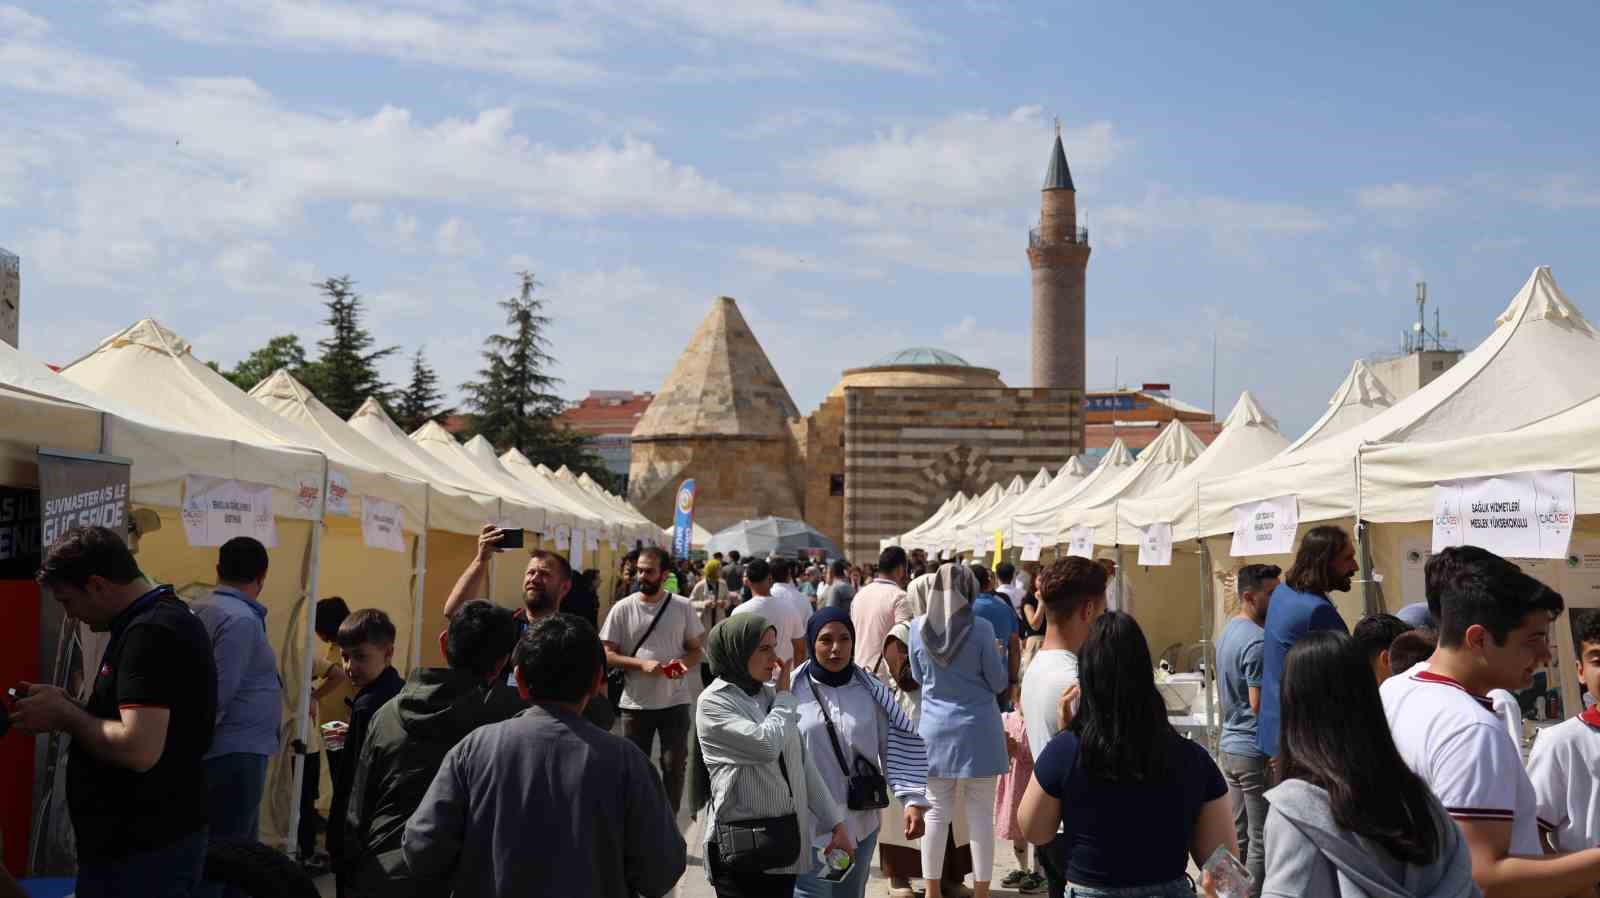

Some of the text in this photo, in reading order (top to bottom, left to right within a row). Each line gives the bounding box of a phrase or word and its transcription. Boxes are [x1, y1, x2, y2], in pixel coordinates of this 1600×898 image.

[1471, 500, 1490, 513] SAĞLIK
[1470, 516, 1528, 529] MESLEK YÜKSEKOKULU
